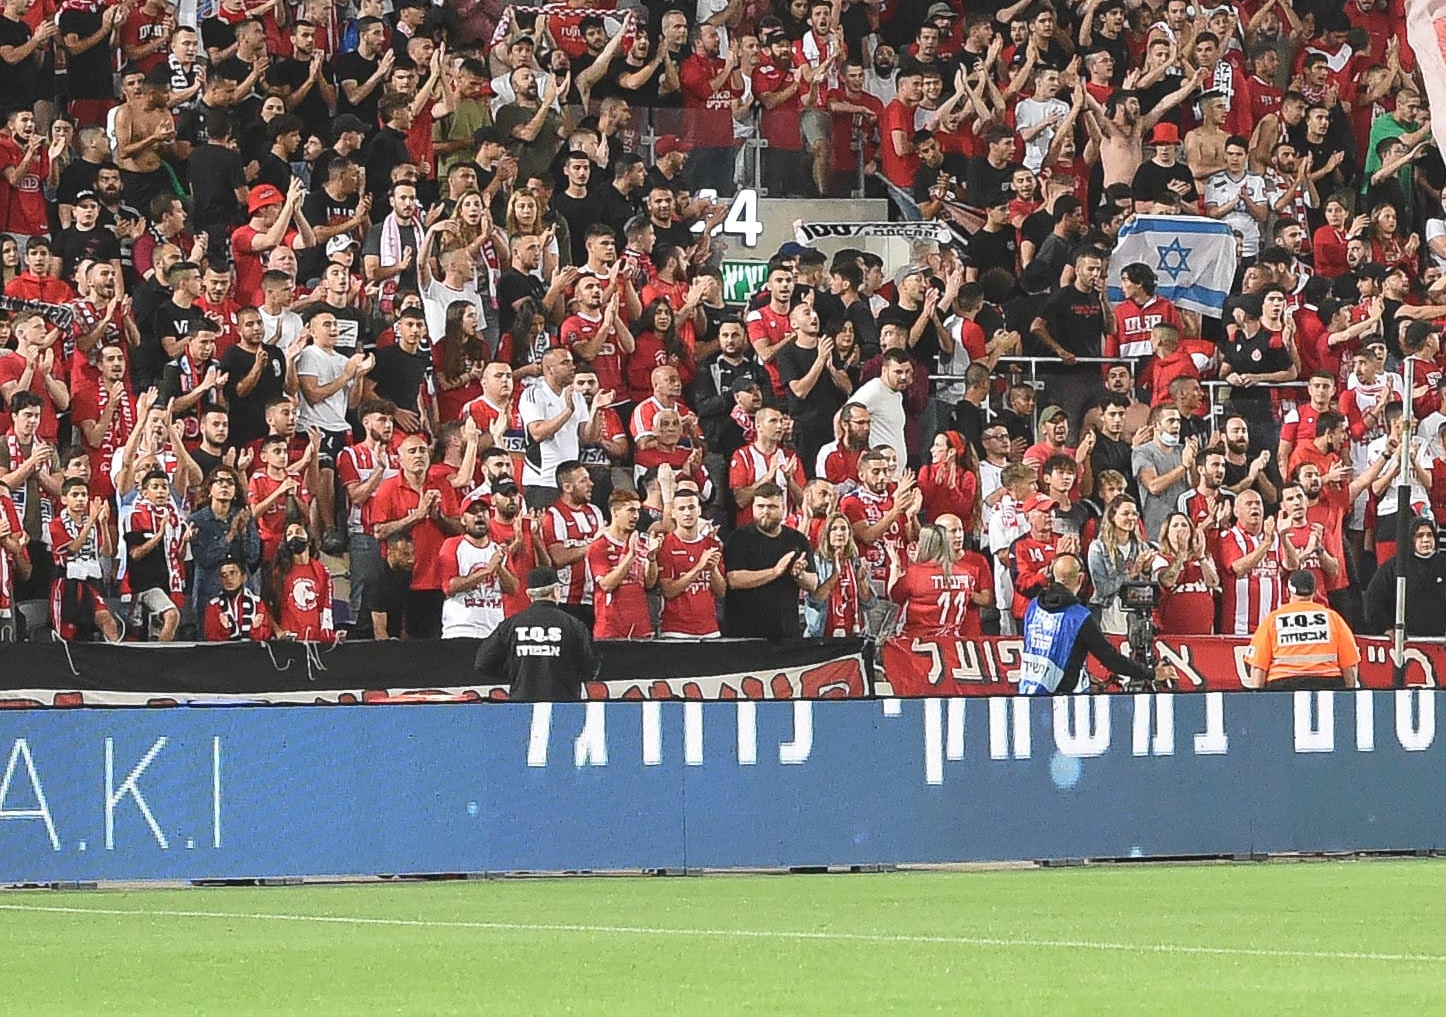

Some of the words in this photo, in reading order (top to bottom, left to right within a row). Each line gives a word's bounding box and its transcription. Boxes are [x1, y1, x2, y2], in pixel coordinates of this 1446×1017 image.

[1278, 613, 1327, 629] T.Q.S
[515, 626, 562, 642] T.Q.S
[1279, 629, 1328, 644] אבטחה
[911, 637, 1023, 684] פועל
